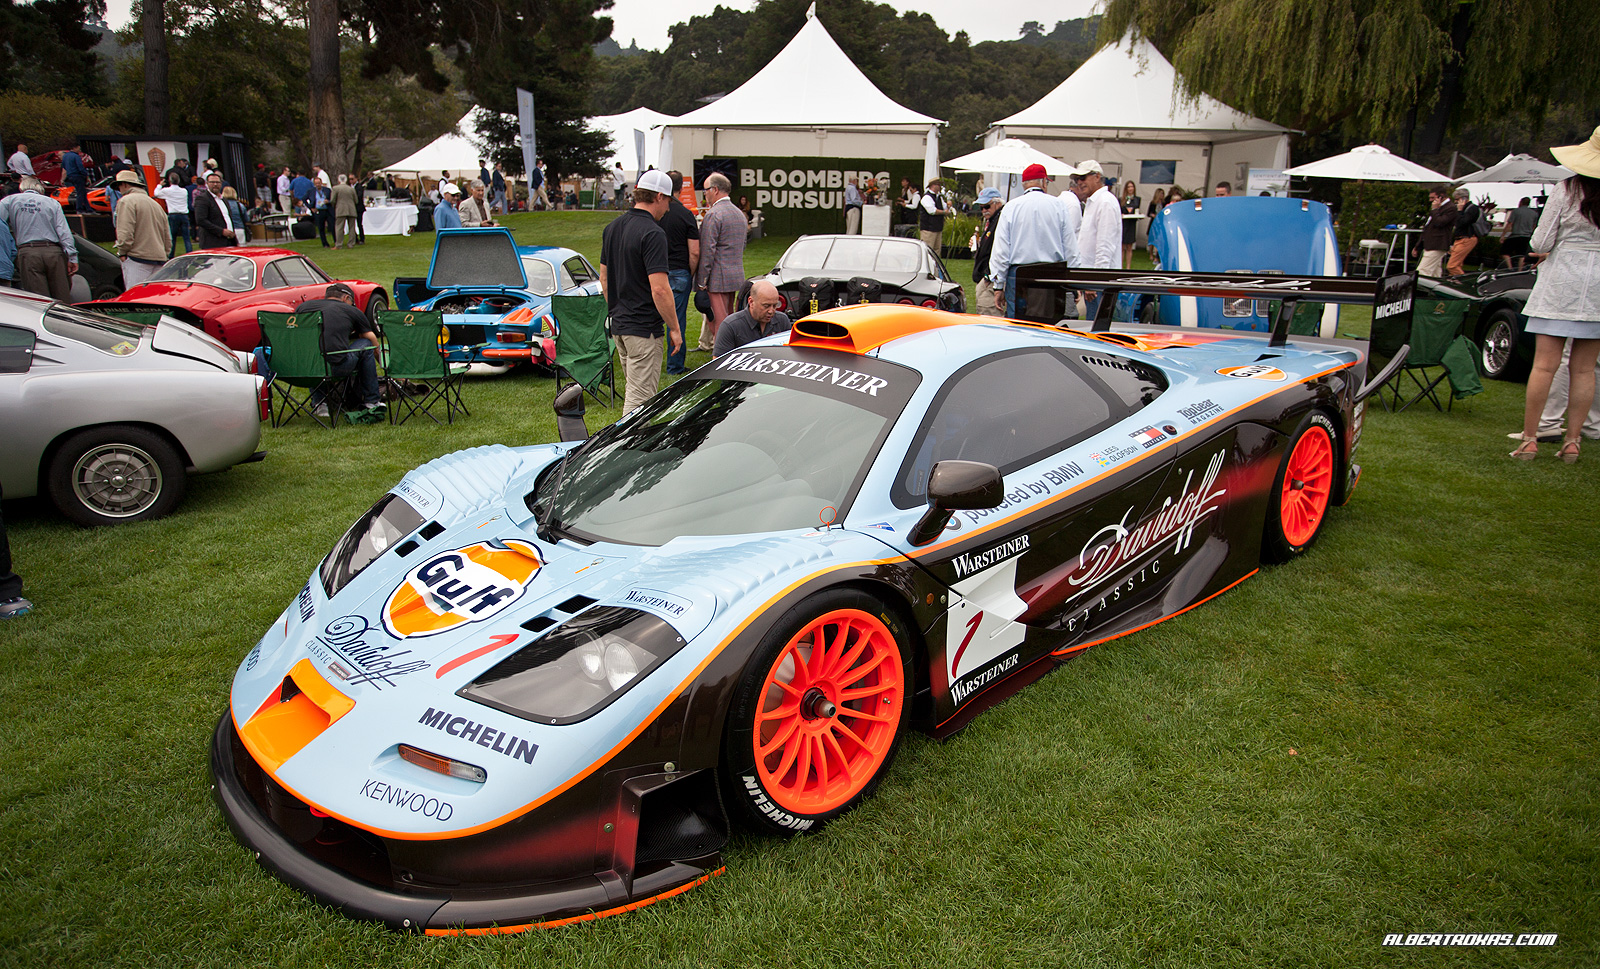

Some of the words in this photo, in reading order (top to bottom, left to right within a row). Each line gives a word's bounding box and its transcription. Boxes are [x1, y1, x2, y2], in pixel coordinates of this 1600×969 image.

[756, 190, 846, 209] PURSUI
[1375, 299, 1412, 319] MICHELIN
[1190, 406, 1225, 425] MAGAZINE
[1311, 414, 1336, 439] MICHELIN
[1023, 479, 1051, 495] by
[1043, 461, 1084, 486] BMW
[1067, 449, 1227, 587] Davidoff
[417, 555, 515, 614] Gulf
[1067, 560, 1160, 632] CLASSIC
[305, 640, 332, 664] CLASSIC
[322, 615, 431, 688] Davidoff
[436, 634, 519, 679] 1
[952, 610, 983, 679] 1
[418, 707, 539, 764] MICHELIN
[360, 779, 454, 822] KENWOOD
[742, 775, 815, 831] MICHELIN
